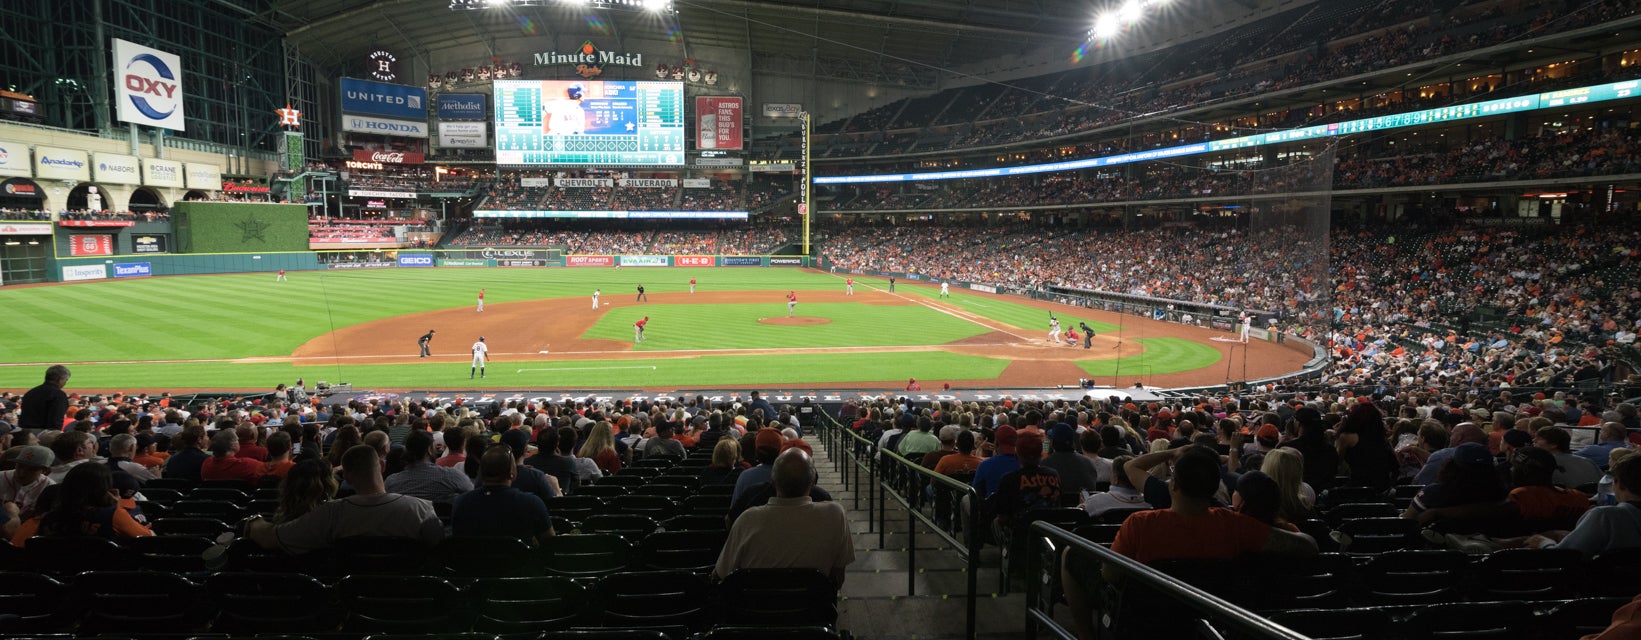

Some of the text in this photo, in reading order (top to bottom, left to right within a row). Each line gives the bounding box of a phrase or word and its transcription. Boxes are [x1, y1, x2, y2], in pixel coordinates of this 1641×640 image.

[370, 51, 396, 61] HOUSTON
[533, 50, 642, 67] Minute Maid
[379, 60, 390, 72] H
[125, 74, 177, 99] OXY
[347, 90, 404, 105] UNITED
[441, 101, 481, 110] Methodist
[281, 108, 300, 126] H
[365, 120, 420, 133] HONDA
[371, 151, 405, 164] Coca-Cola
[108, 165, 135, 173] NABORS
[155, 165, 176, 174] CRANE
[222, 181, 270, 192] Budweiser
[560, 179, 608, 187] CHEVROLET
[626, 179, 672, 187] SILVERADO
[494, 249, 535, 258] LEXUS
[74, 268, 103, 278] Insperity
[115, 265, 149, 275] TexanPlus
